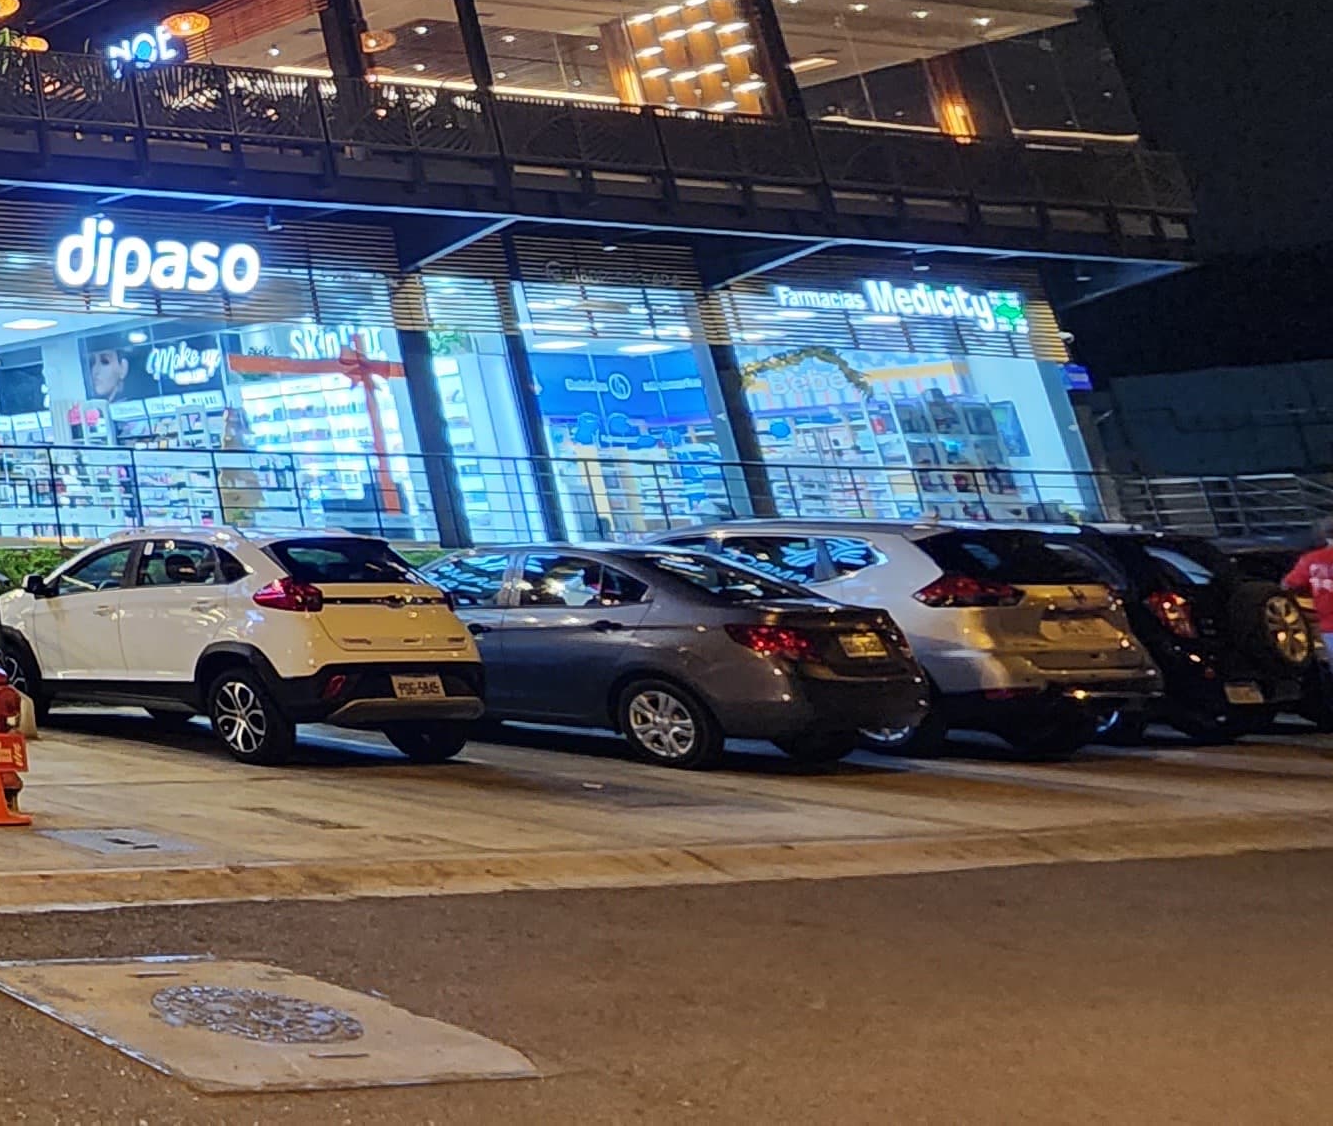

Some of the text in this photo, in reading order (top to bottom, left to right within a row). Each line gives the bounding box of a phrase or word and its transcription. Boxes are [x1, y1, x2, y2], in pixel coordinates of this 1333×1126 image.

[54, 214, 262, 309] dipaso
[773, 279, 996, 332] Farmacias Medicity
